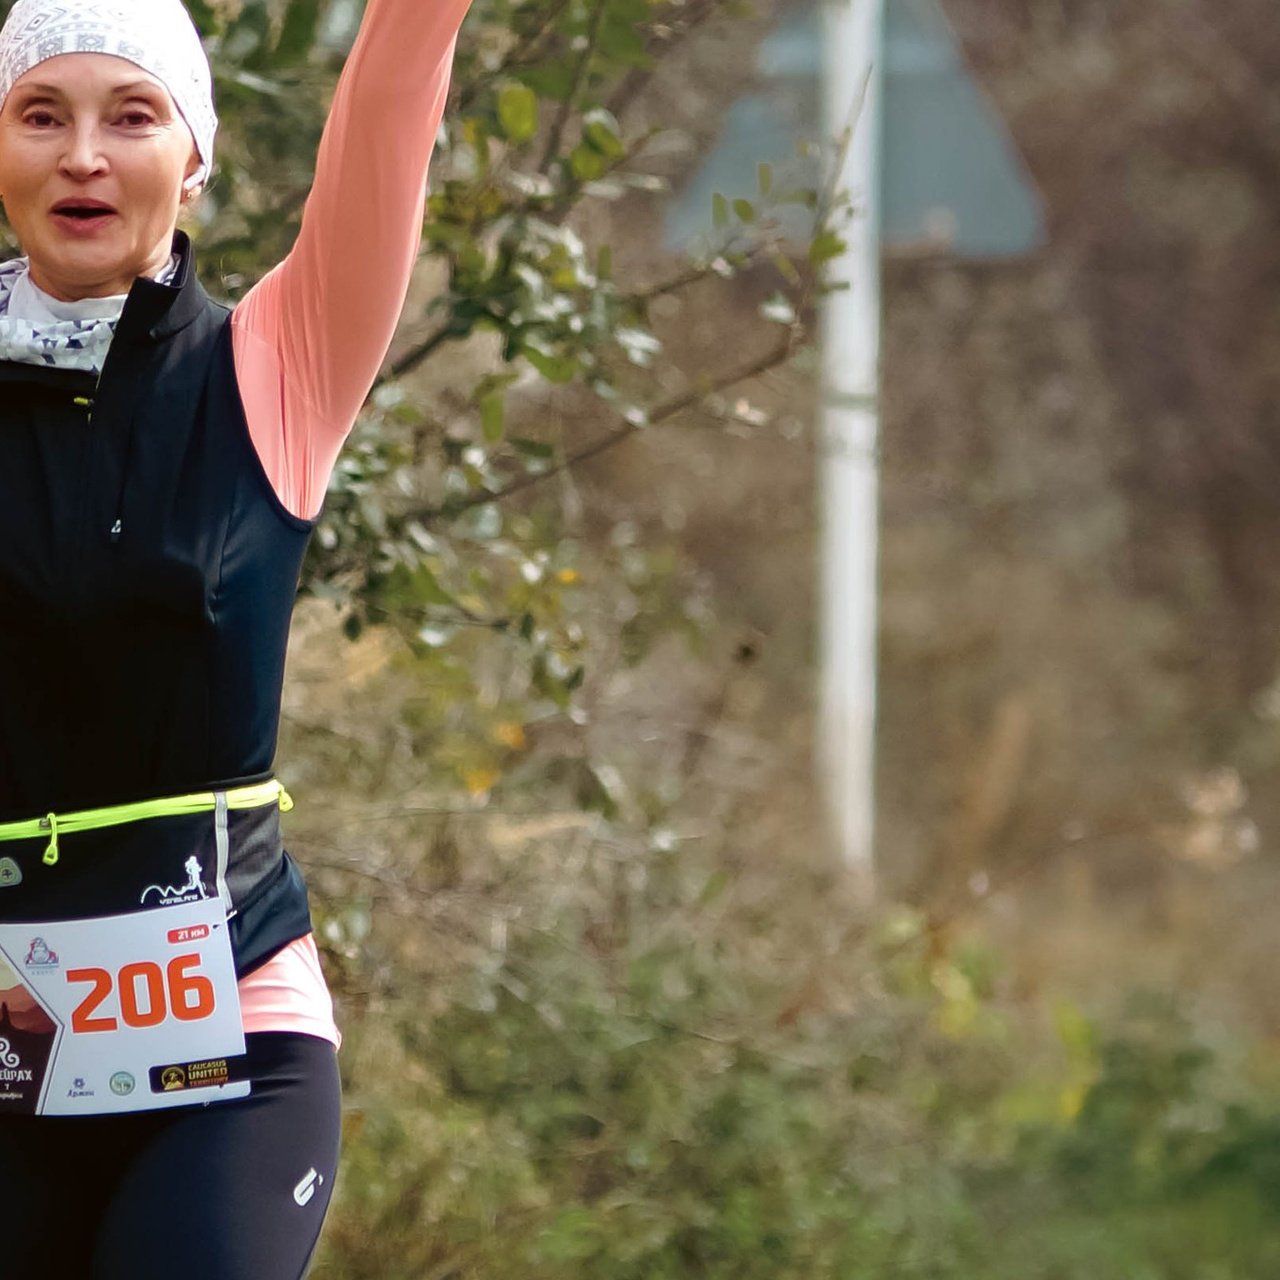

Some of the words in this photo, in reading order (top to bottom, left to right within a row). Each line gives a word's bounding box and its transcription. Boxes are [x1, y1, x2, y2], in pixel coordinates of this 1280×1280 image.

[177, 930, 189, 940] 21
[66, 953, 215, 1033] 206
[188, 1060, 227, 1071] CAUCASUS
[189, 1067, 228, 1080] UNITED
